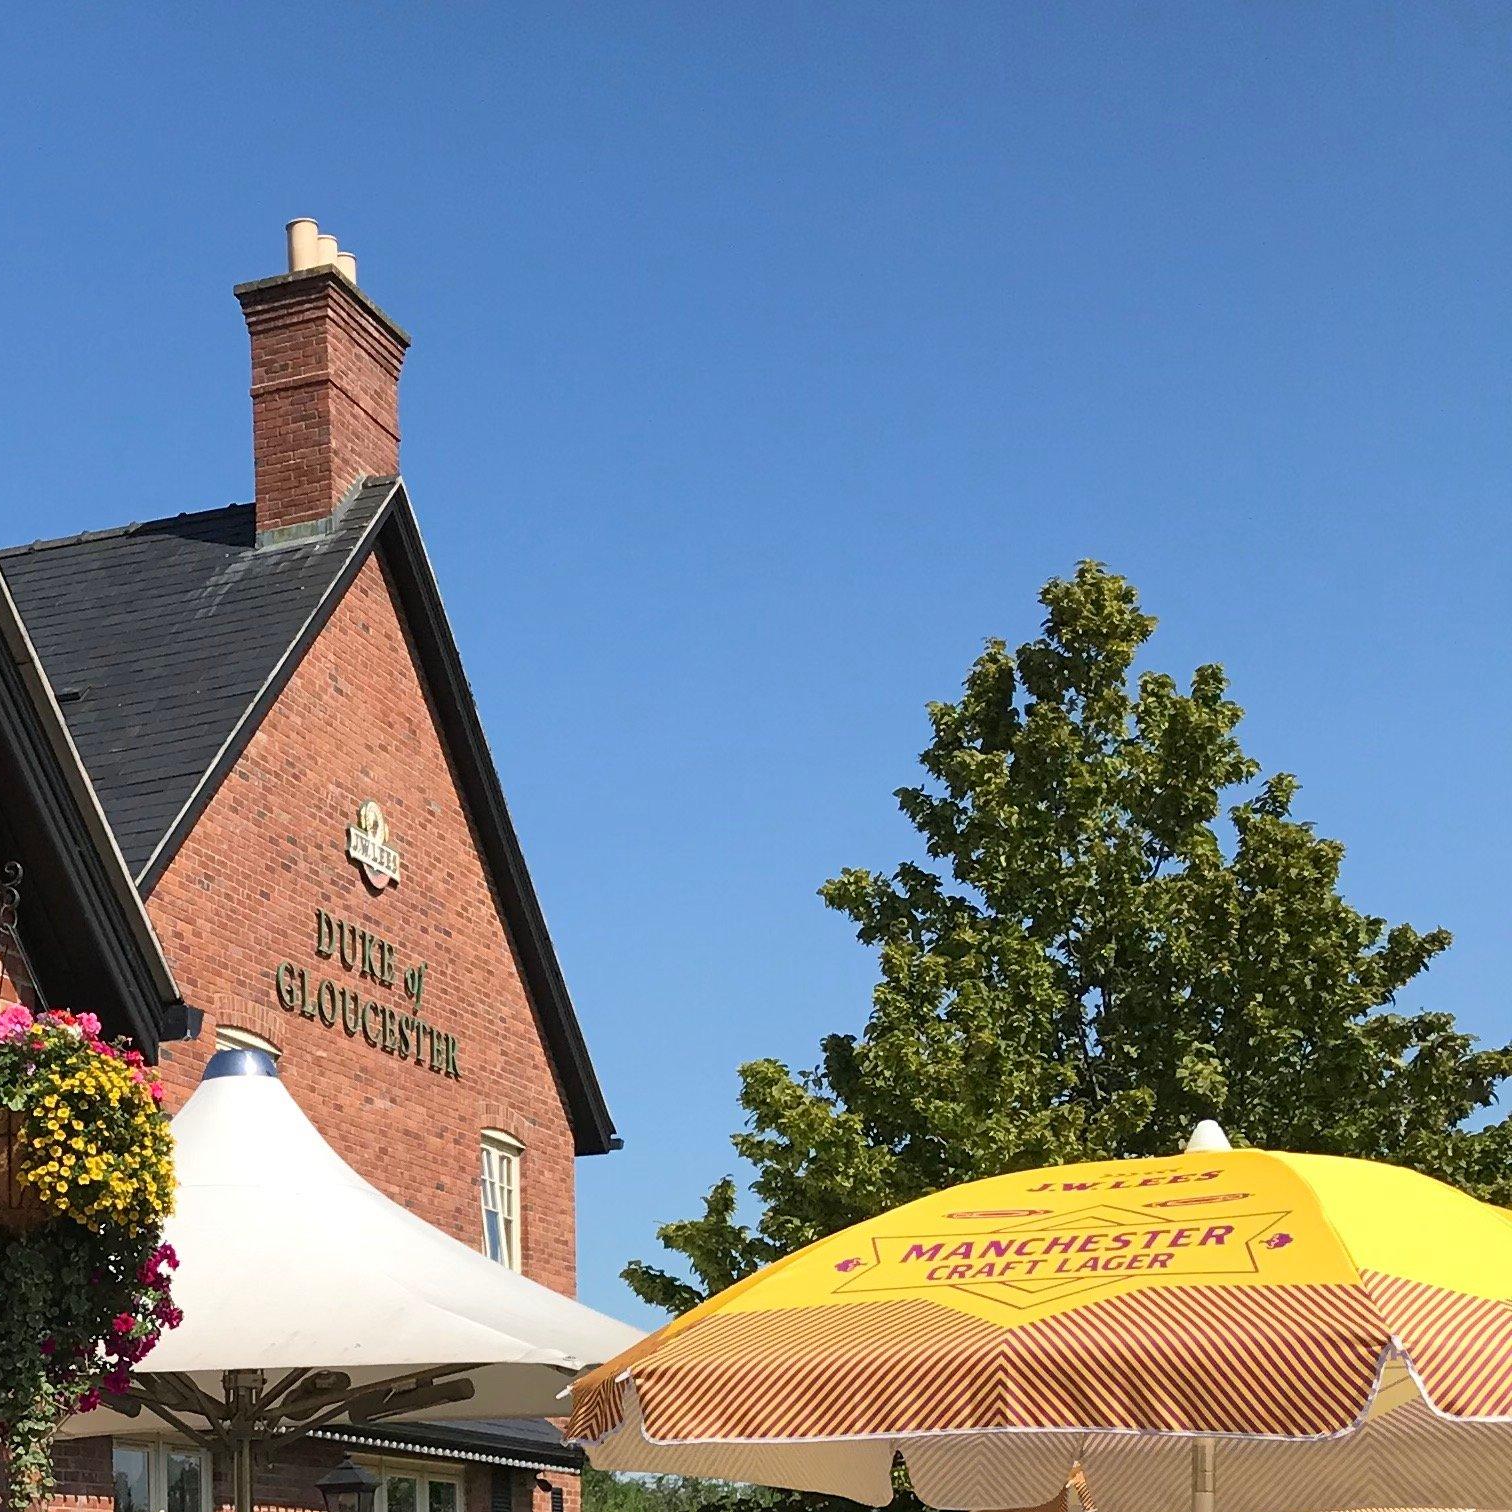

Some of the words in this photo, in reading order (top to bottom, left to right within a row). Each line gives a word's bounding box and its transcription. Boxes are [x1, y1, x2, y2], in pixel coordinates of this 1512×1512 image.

[315, 908, 395, 990] DUKE
[404, 961, 428, 1016] of
[276, 961, 462, 1082] GLOUCESTER
[899, 1224, 1235, 1264] MANCHESTER
[925, 1258, 1048, 1281] CRAFT
[1054, 1252, 1176, 1274] LAGER
